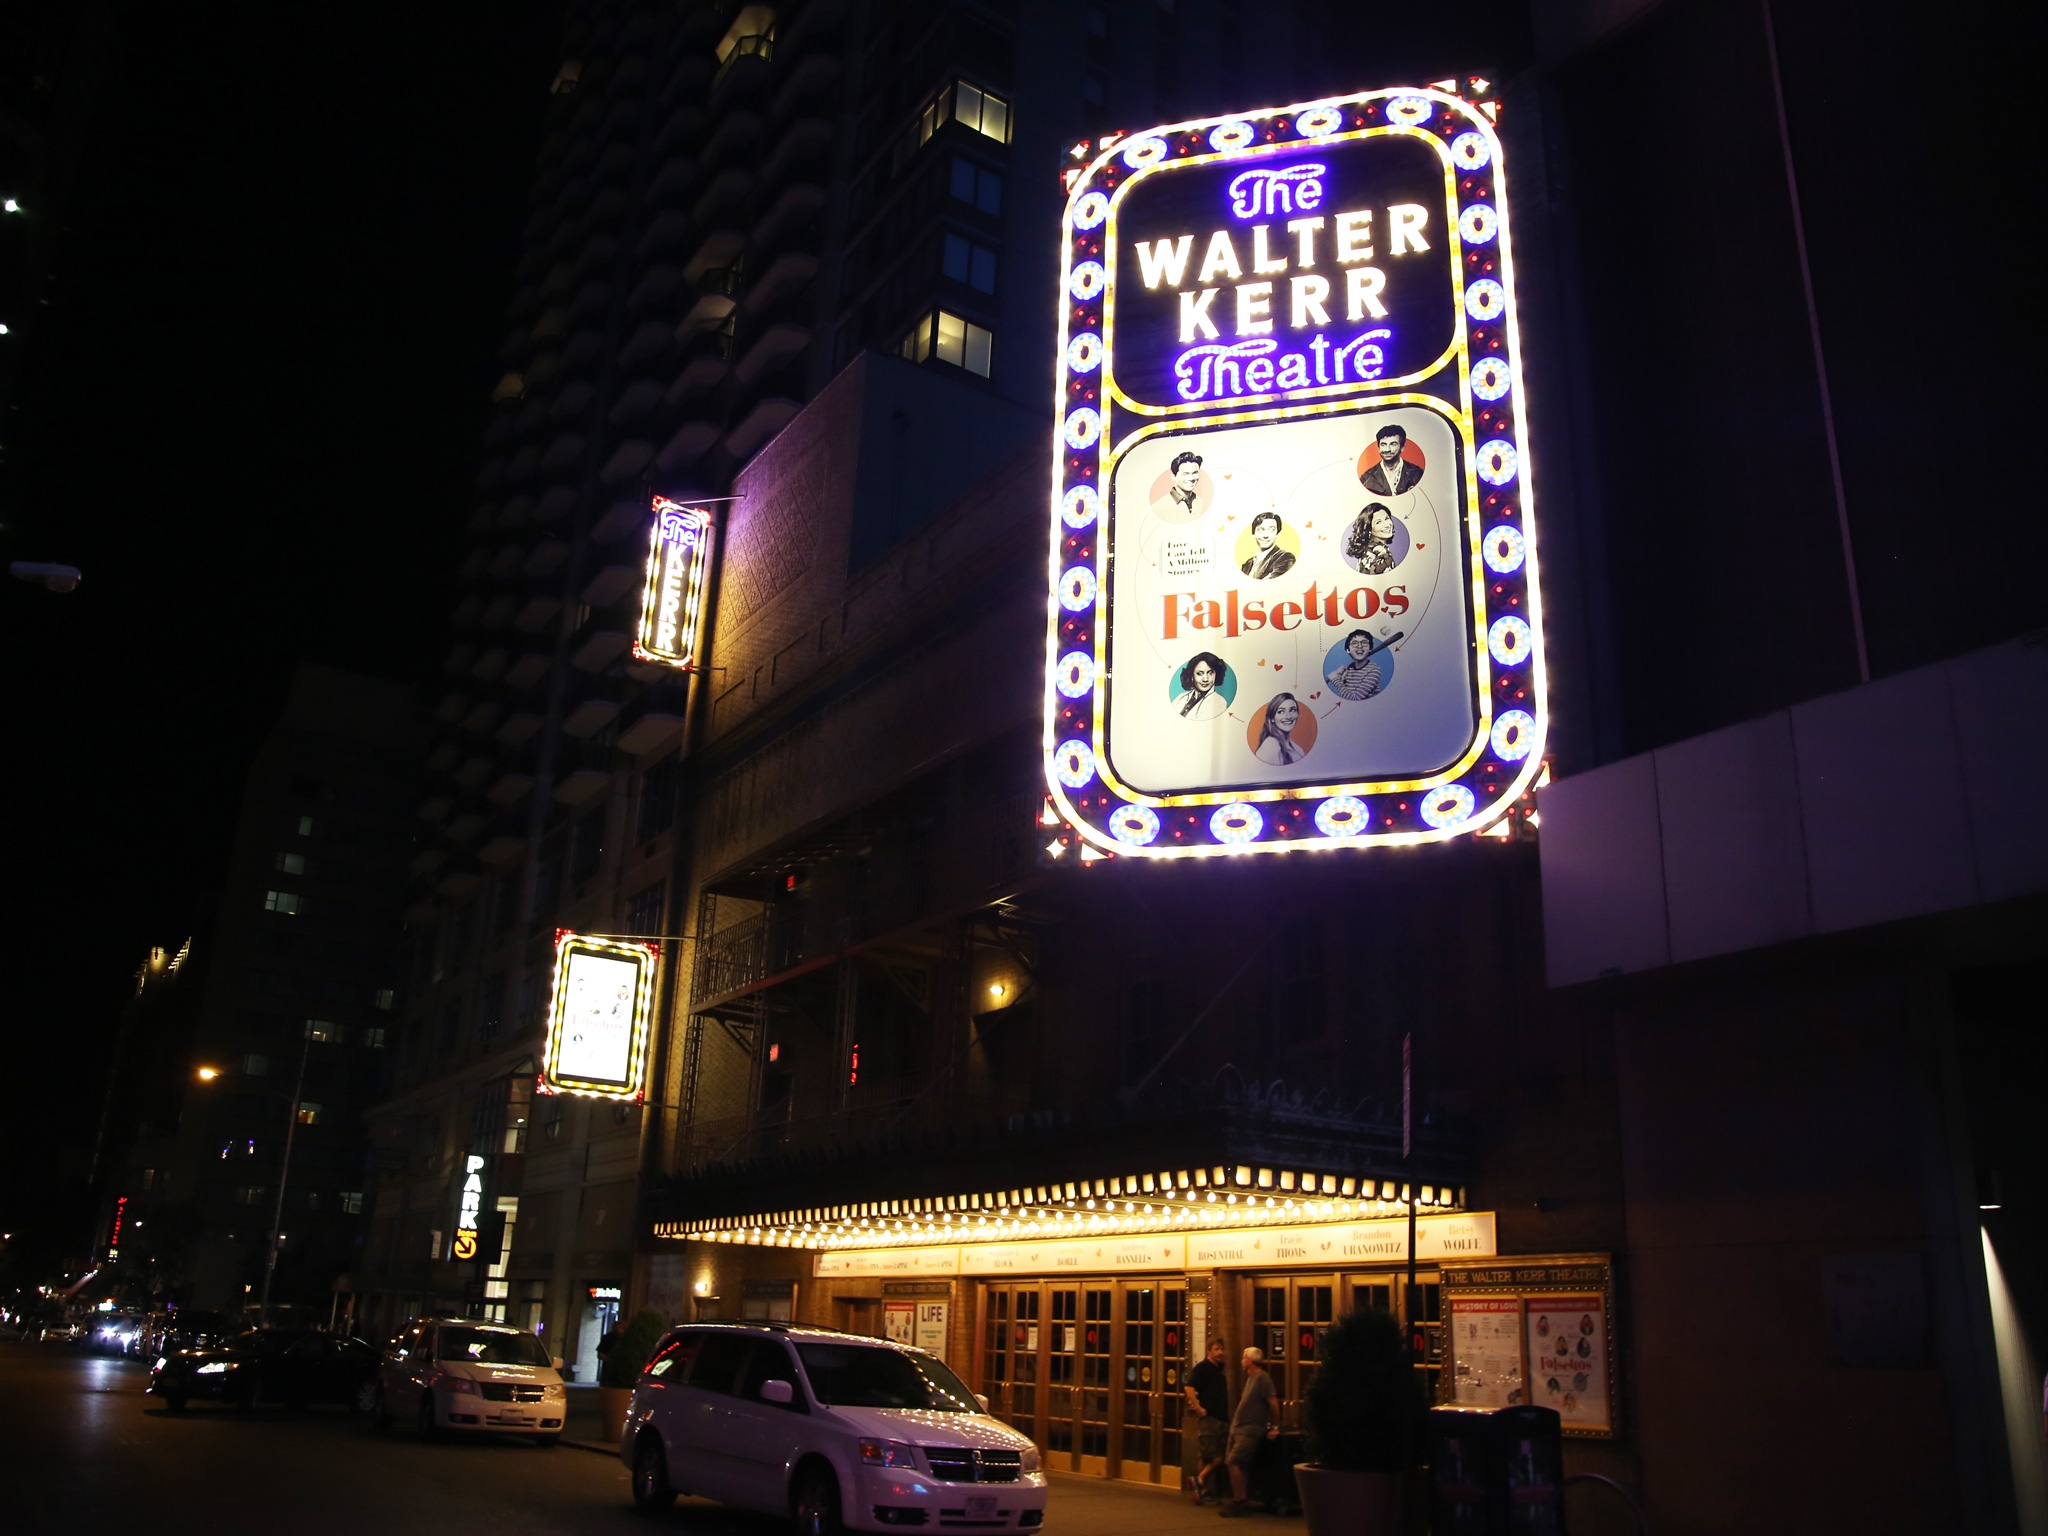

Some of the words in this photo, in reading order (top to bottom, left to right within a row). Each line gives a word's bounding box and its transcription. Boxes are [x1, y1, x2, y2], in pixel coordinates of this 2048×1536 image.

[1229, 163, 1326, 219] The
[1134, 202, 1432, 289] WALTER
[1177, 266, 1390, 343] KERR
[1174, 328, 1392, 401] Theatre
[662, 514, 697, 546] The
[655, 540, 688, 652] KERR
[1159, 579, 1410, 641] Falsettos
[458, 1154, 485, 1231] PARK
[456, 1228, 478, 1239] icon
[1352, 1229, 1392, 1242] Brandon
[1443, 1237, 1482, 1251] WOLFE
[1198, 1249, 1245, 1261] ROSENTHAL
[1275, 1247, 1307, 1259] THOMS
[1343, 1241, 1402, 1256] URANOWITZ
[1448, 1272, 1468, 1284] THE
[1471, 1270, 1513, 1283] WALTER
[1516, 1269, 1547, 1282] KERR
[1549, 1268, 1602, 1281] THEATRE
[921, 1305, 943, 1323] LIFE
